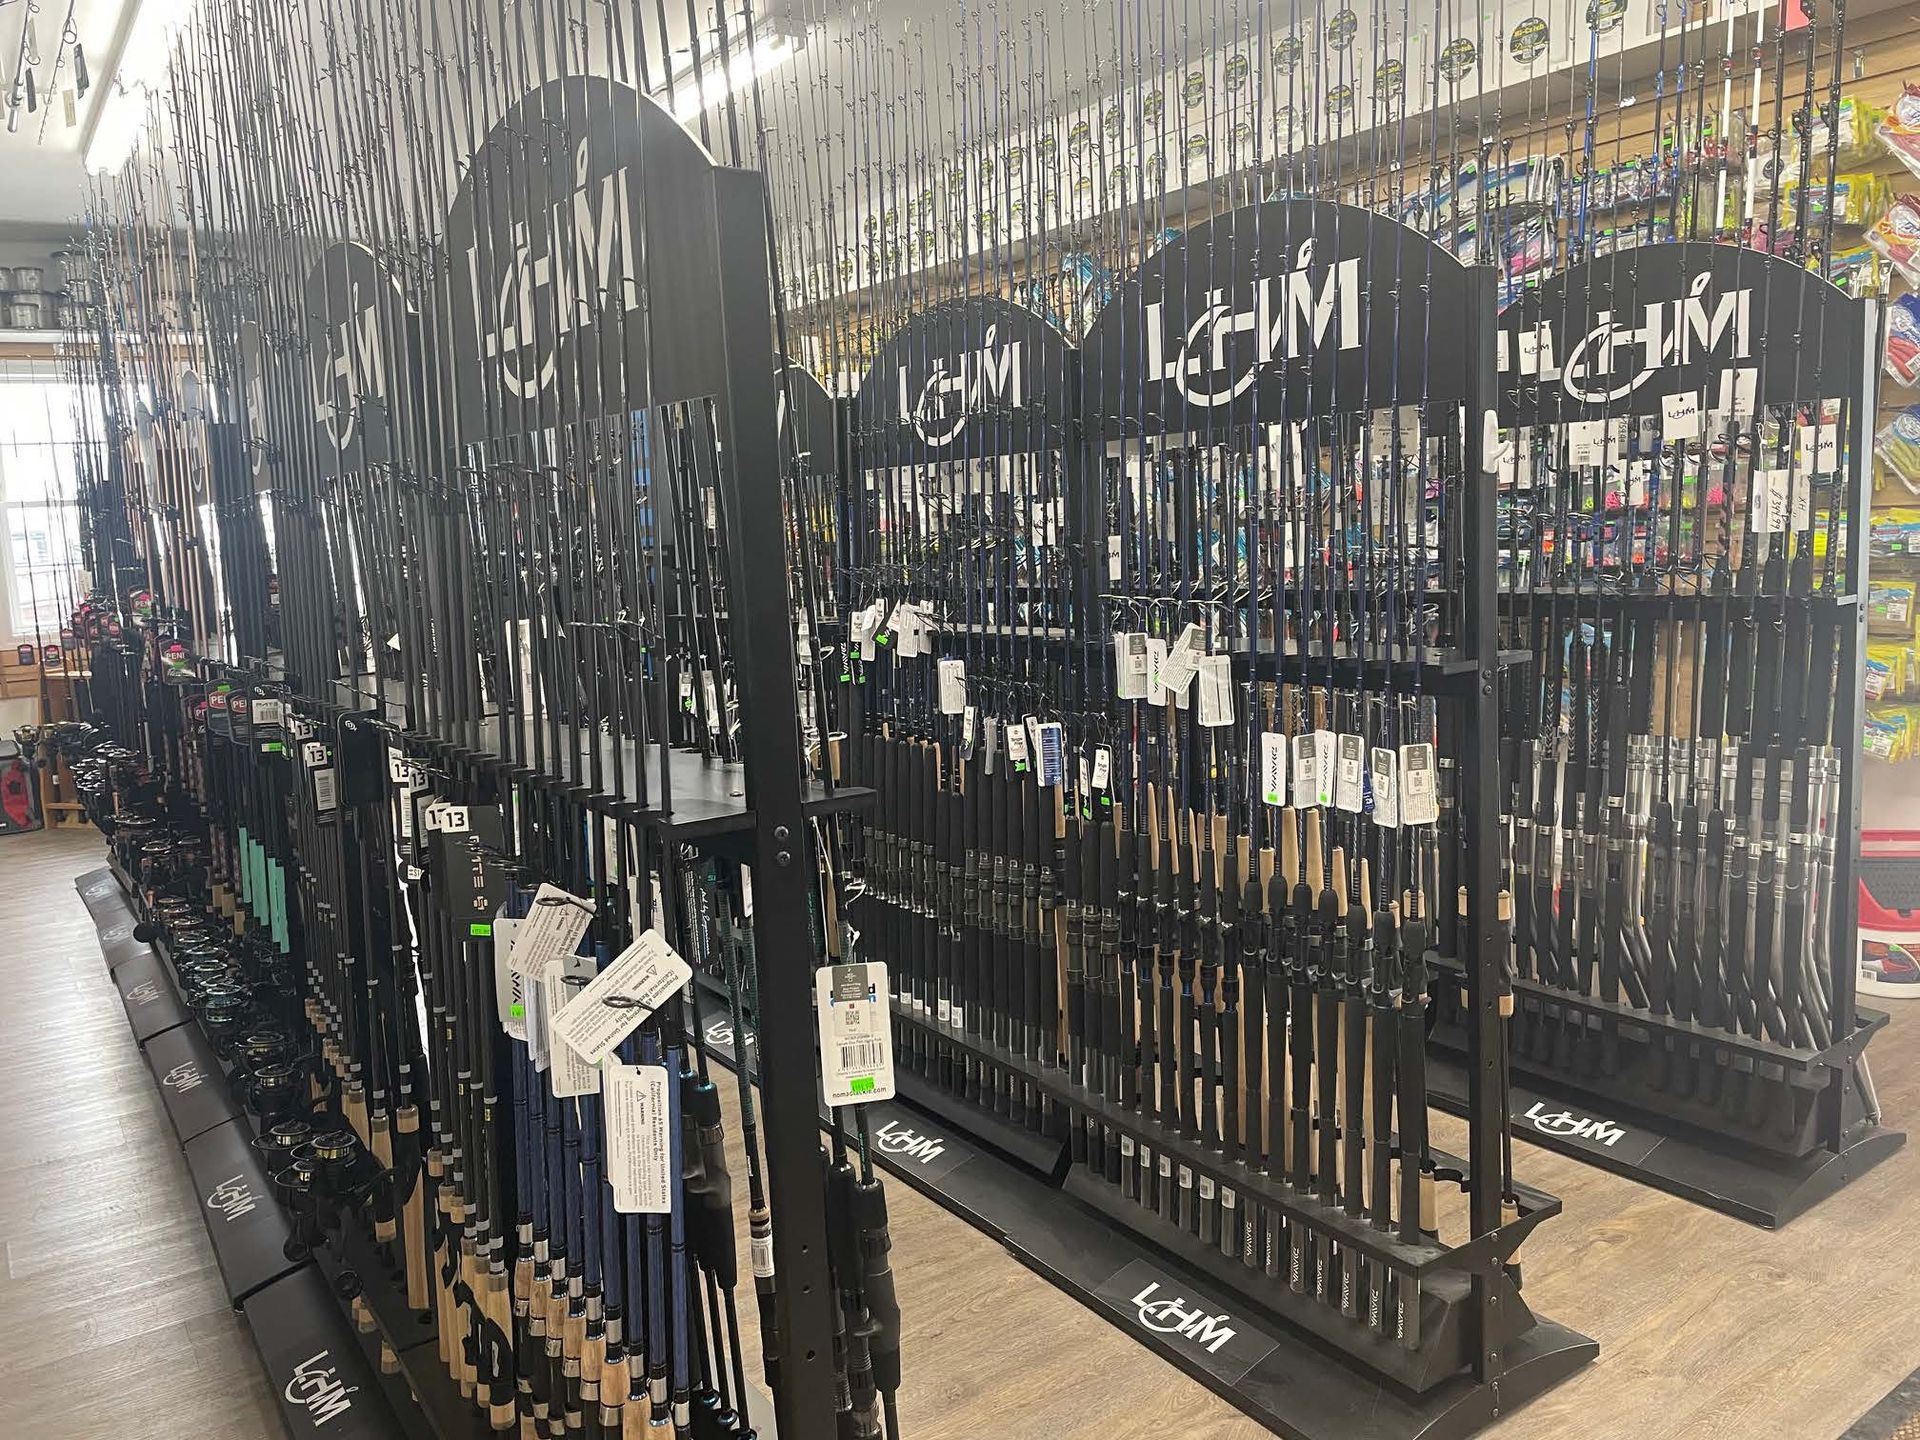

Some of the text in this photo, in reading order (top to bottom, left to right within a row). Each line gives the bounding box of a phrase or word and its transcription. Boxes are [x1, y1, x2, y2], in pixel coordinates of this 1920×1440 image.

[1668, 407, 1695, 420] LHM
[297, 724, 311, 736] 13
[310, 749, 325, 763] 13
[395, 763, 409, 778] 13
[412, 772, 426, 787] 13
[446, 811, 465, 828] 13
[1524, 1101, 1627, 1147] LHM
[875, 1120, 946, 1164] LHM
[207, 1174, 264, 1222] LHM
[1131, 1282, 1238, 1354] LHM
[285, 1350, 359, 1427] LHM
